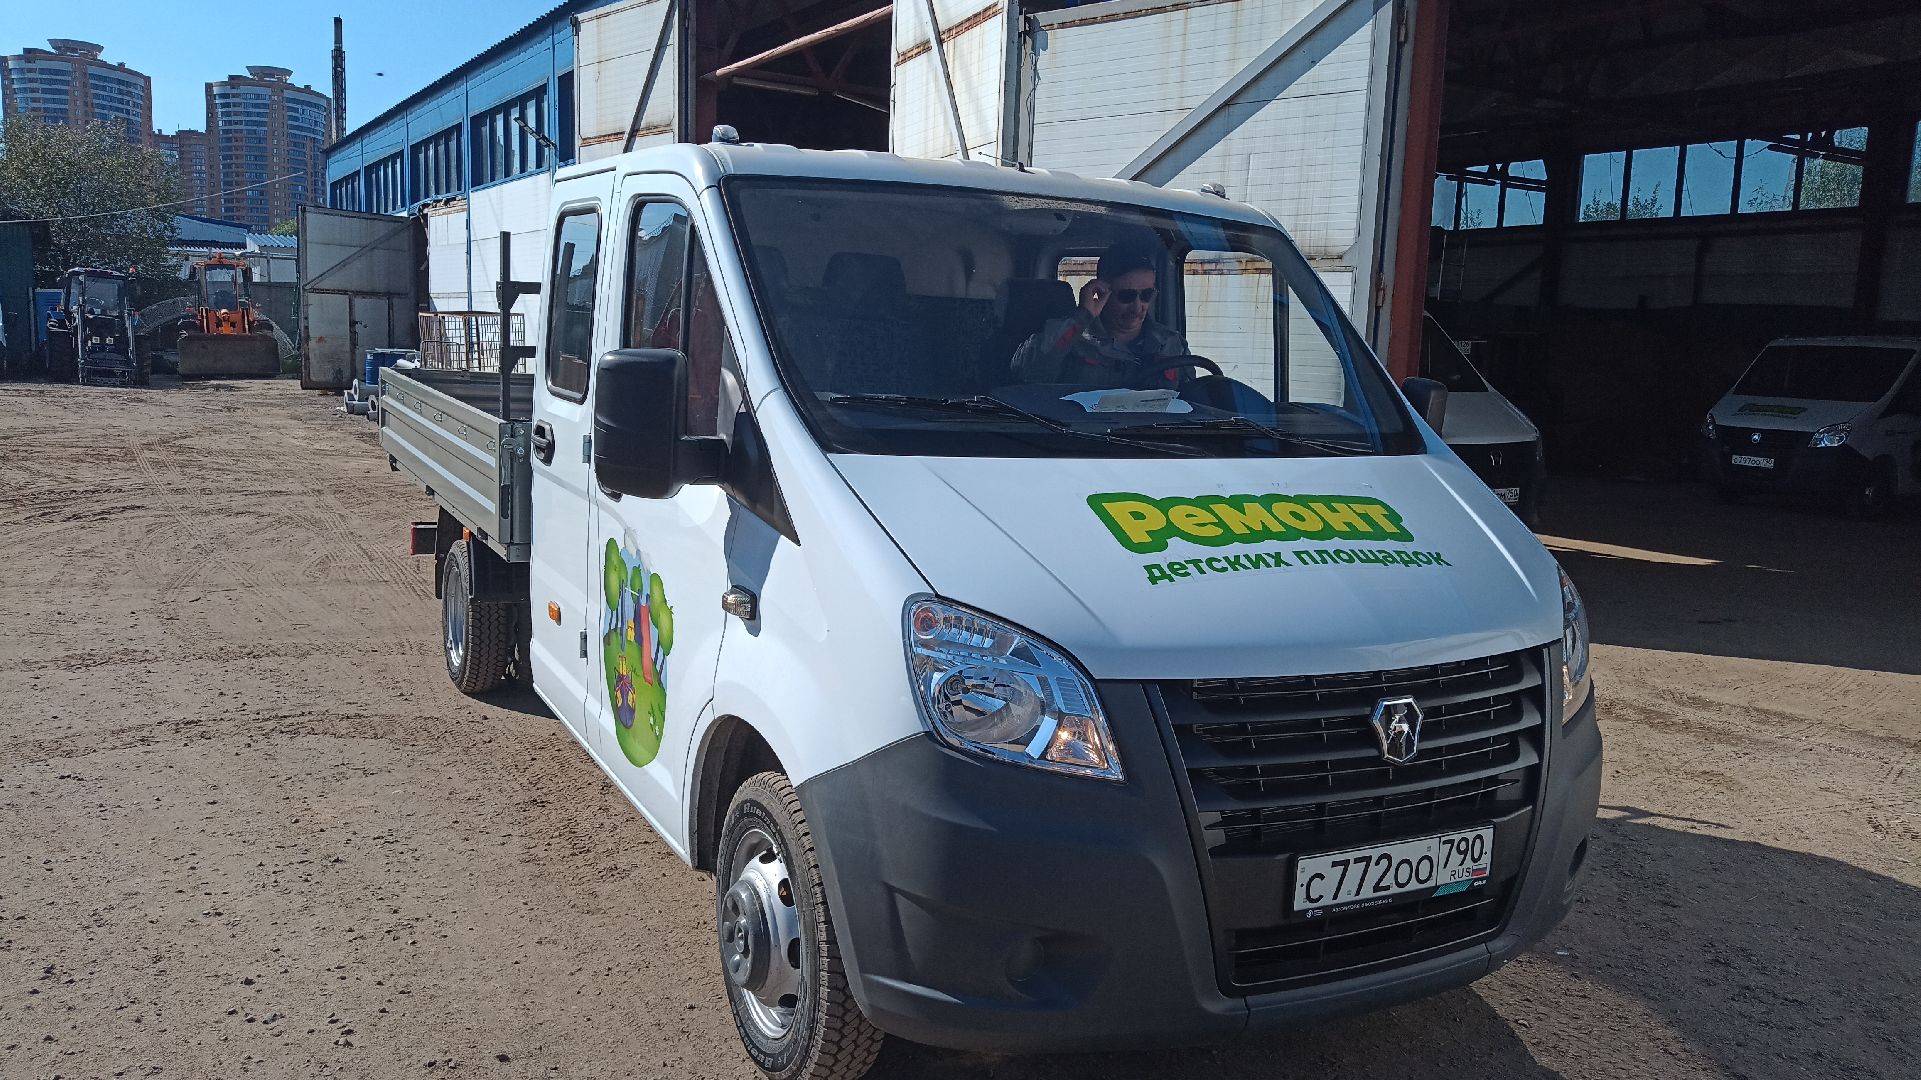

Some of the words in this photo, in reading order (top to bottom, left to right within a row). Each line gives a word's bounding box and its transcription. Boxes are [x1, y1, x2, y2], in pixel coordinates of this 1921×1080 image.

[1142, 551, 1293, 586] детских
[1292, 549, 1453, 569] площадок
[1442, 833, 1485, 870] 790
[1449, 867, 1472, 881] RUS
